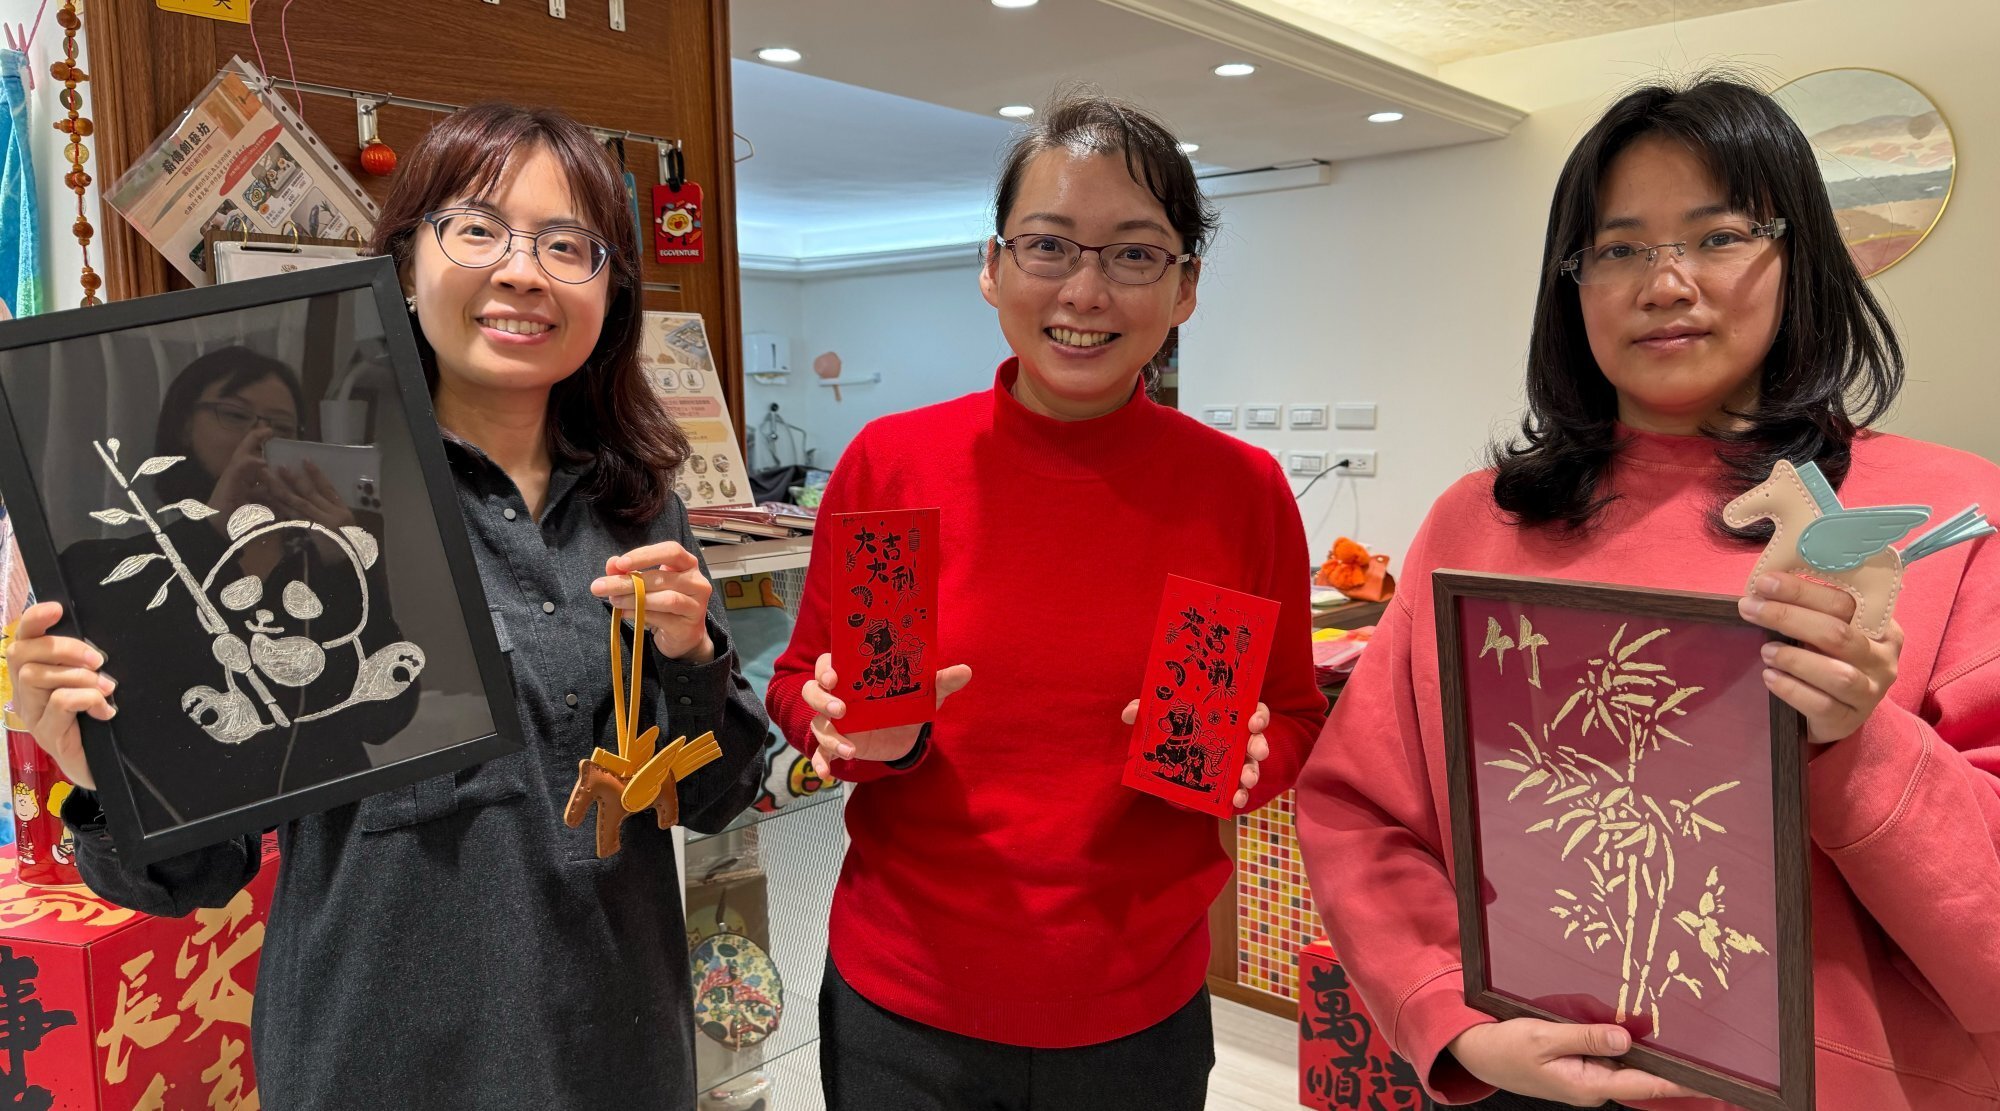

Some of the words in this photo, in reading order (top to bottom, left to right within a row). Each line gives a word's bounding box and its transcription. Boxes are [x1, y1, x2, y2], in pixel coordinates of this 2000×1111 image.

[660, 249, 699, 257] EGGVENTURE
[854, 526, 901, 560] 大吉
[866, 557, 915, 592] 大利
[1179, 606, 1231, 654] 大吉
[1479, 614, 1549, 689] 竹
[1300, 963, 1371, 1057] 萬
